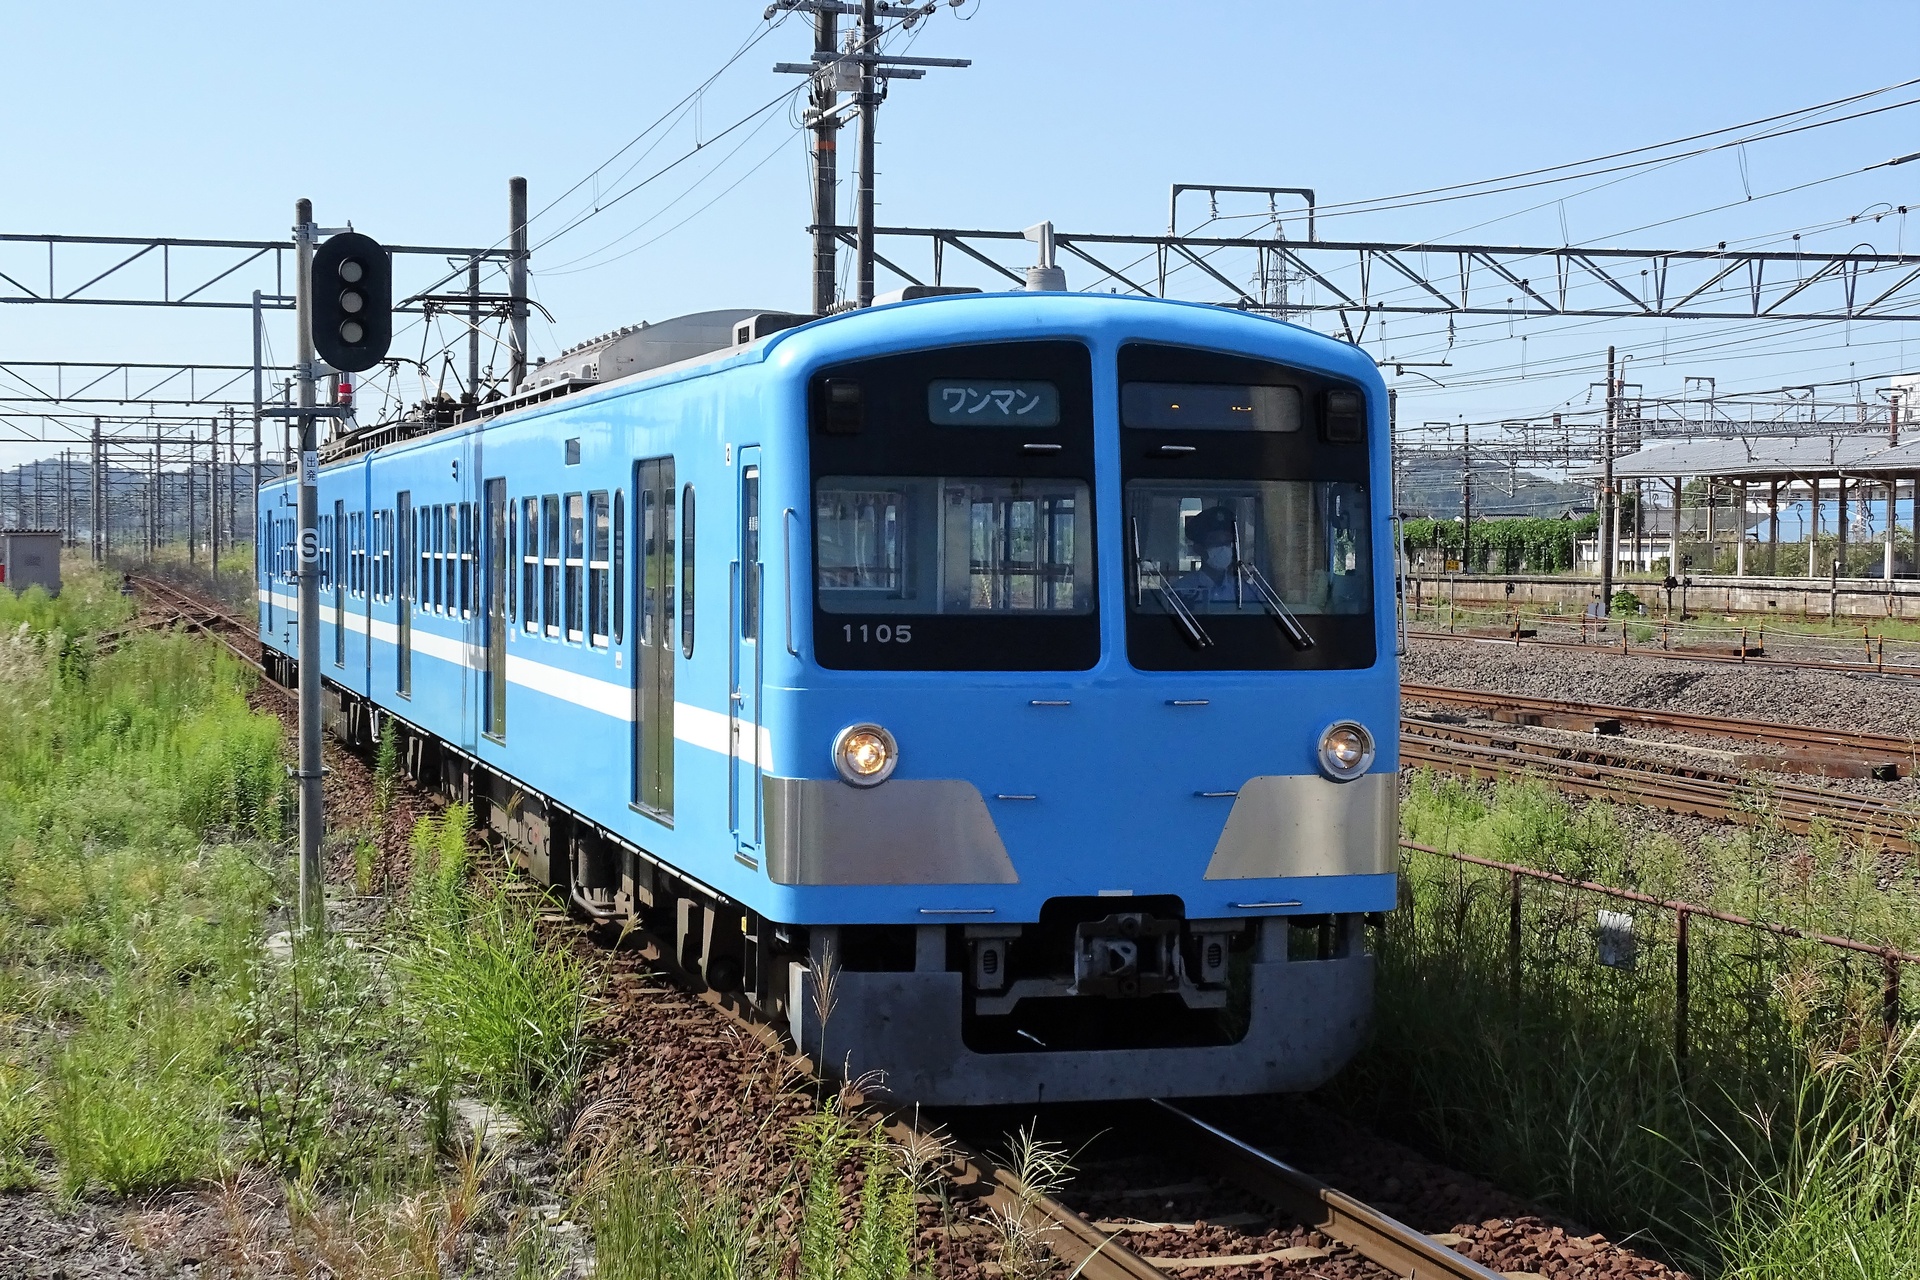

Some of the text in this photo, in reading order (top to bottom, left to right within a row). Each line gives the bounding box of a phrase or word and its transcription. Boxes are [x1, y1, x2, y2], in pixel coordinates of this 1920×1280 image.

[942, 387, 1040, 415] ワンマン
[306, 456, 316, 481] 出発
[301, 532, 318, 558] S
[842, 624, 912, 643] 1105
